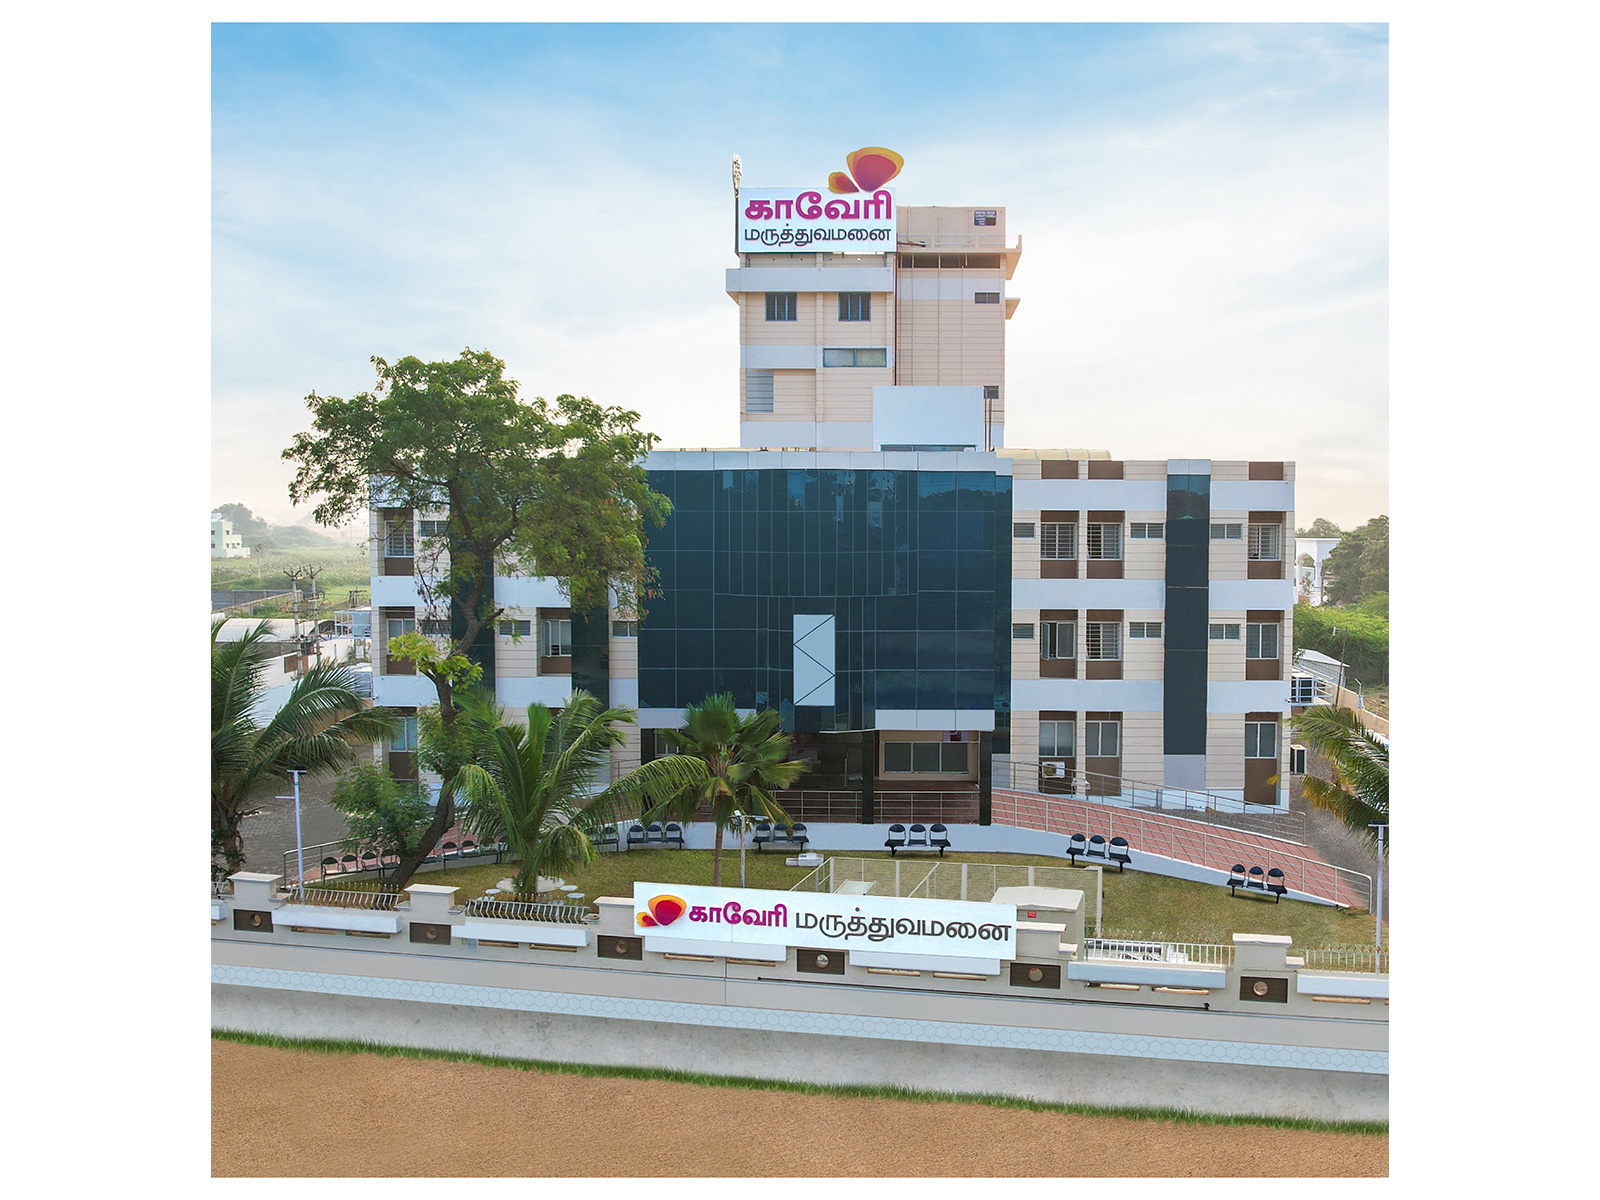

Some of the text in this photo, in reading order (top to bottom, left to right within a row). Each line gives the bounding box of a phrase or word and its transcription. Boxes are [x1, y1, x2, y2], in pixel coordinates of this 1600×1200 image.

[745, 190, 892, 220] காவேரி
[744, 223, 892, 247] மருத்துவமனை
[688, 902, 1012, 942] காவேரி மருத்துவமனை
